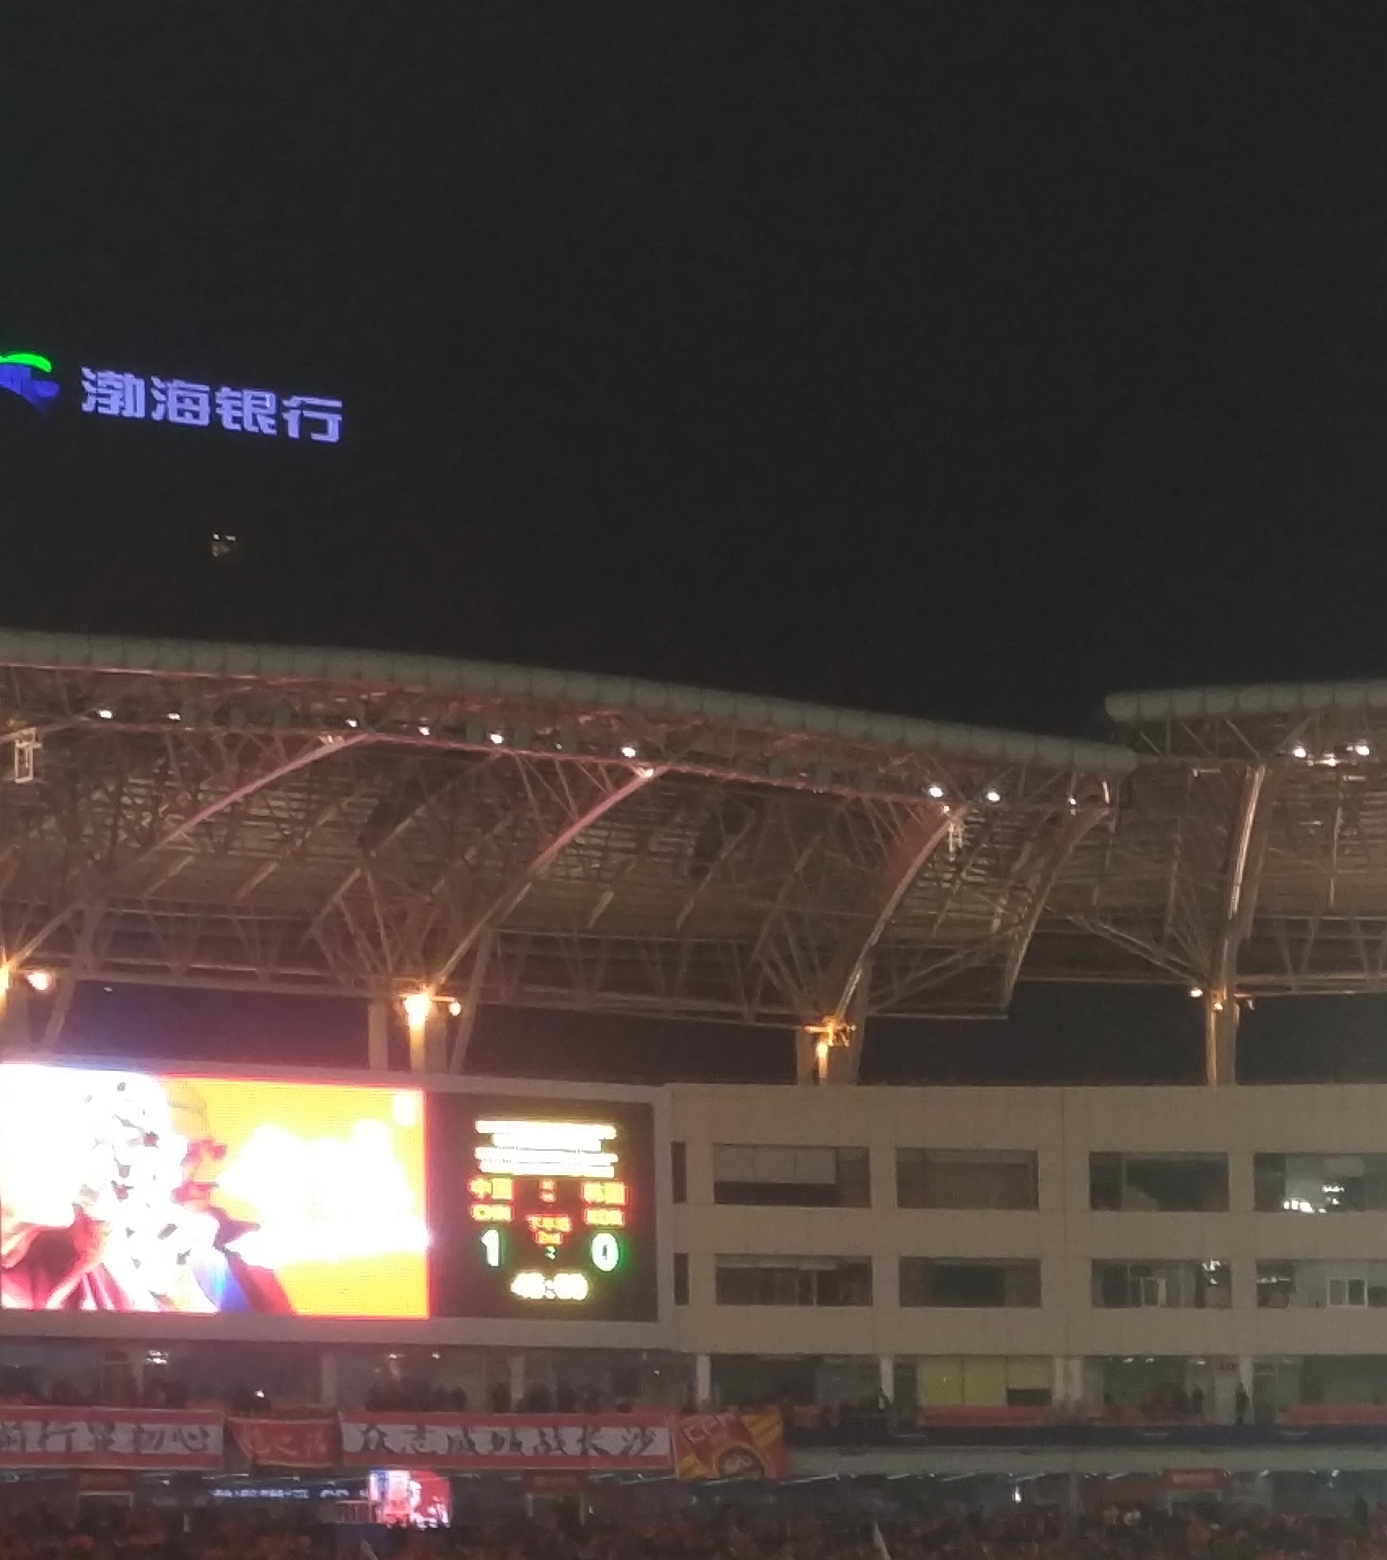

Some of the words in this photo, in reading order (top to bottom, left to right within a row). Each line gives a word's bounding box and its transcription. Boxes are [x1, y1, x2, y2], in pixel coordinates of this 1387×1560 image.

[80, 365, 343, 443] 渤海银行
[481, 1229, 501, 1267] 1
[591, 1232, 620, 1272] 0
